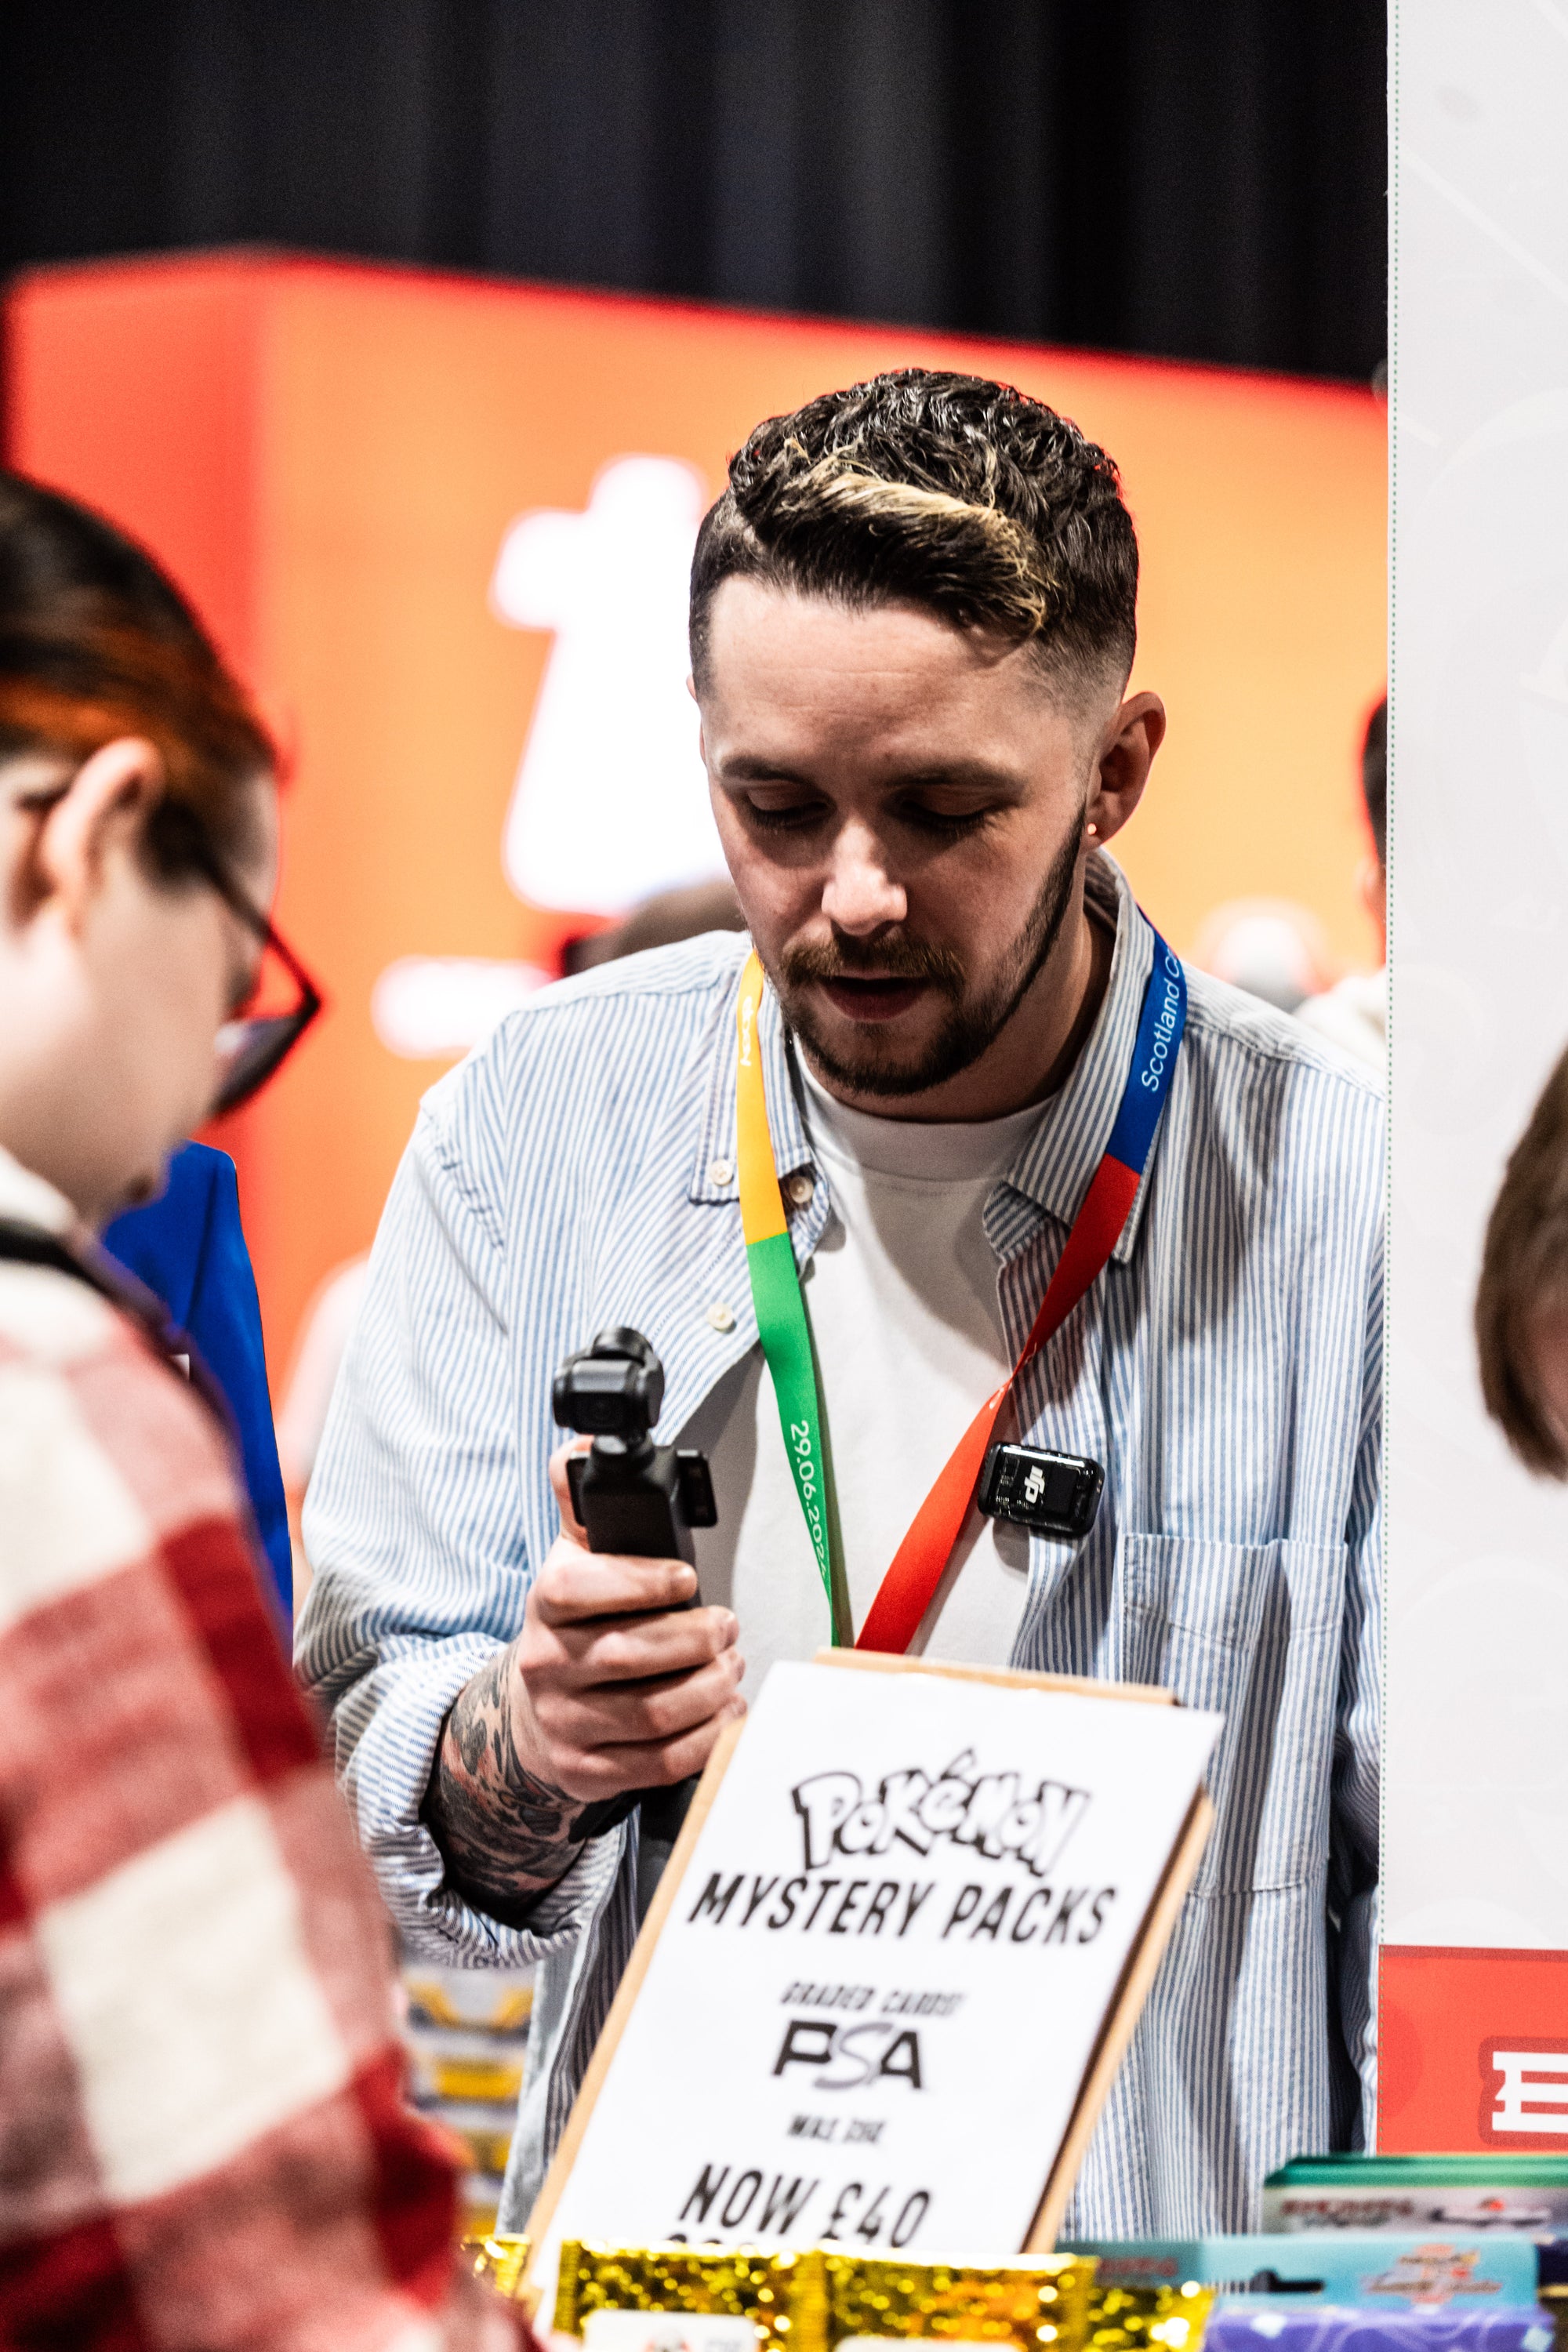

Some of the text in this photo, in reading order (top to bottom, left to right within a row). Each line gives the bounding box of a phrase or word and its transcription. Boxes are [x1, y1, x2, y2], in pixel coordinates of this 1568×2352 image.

[1142, 978, 1180, 1092] Scotland
[687, 1871, 1118, 1945] MYSTERY PACKS
[772, 2019, 923, 2091] PSA
[679, 2164, 931, 2249] NOW £40
